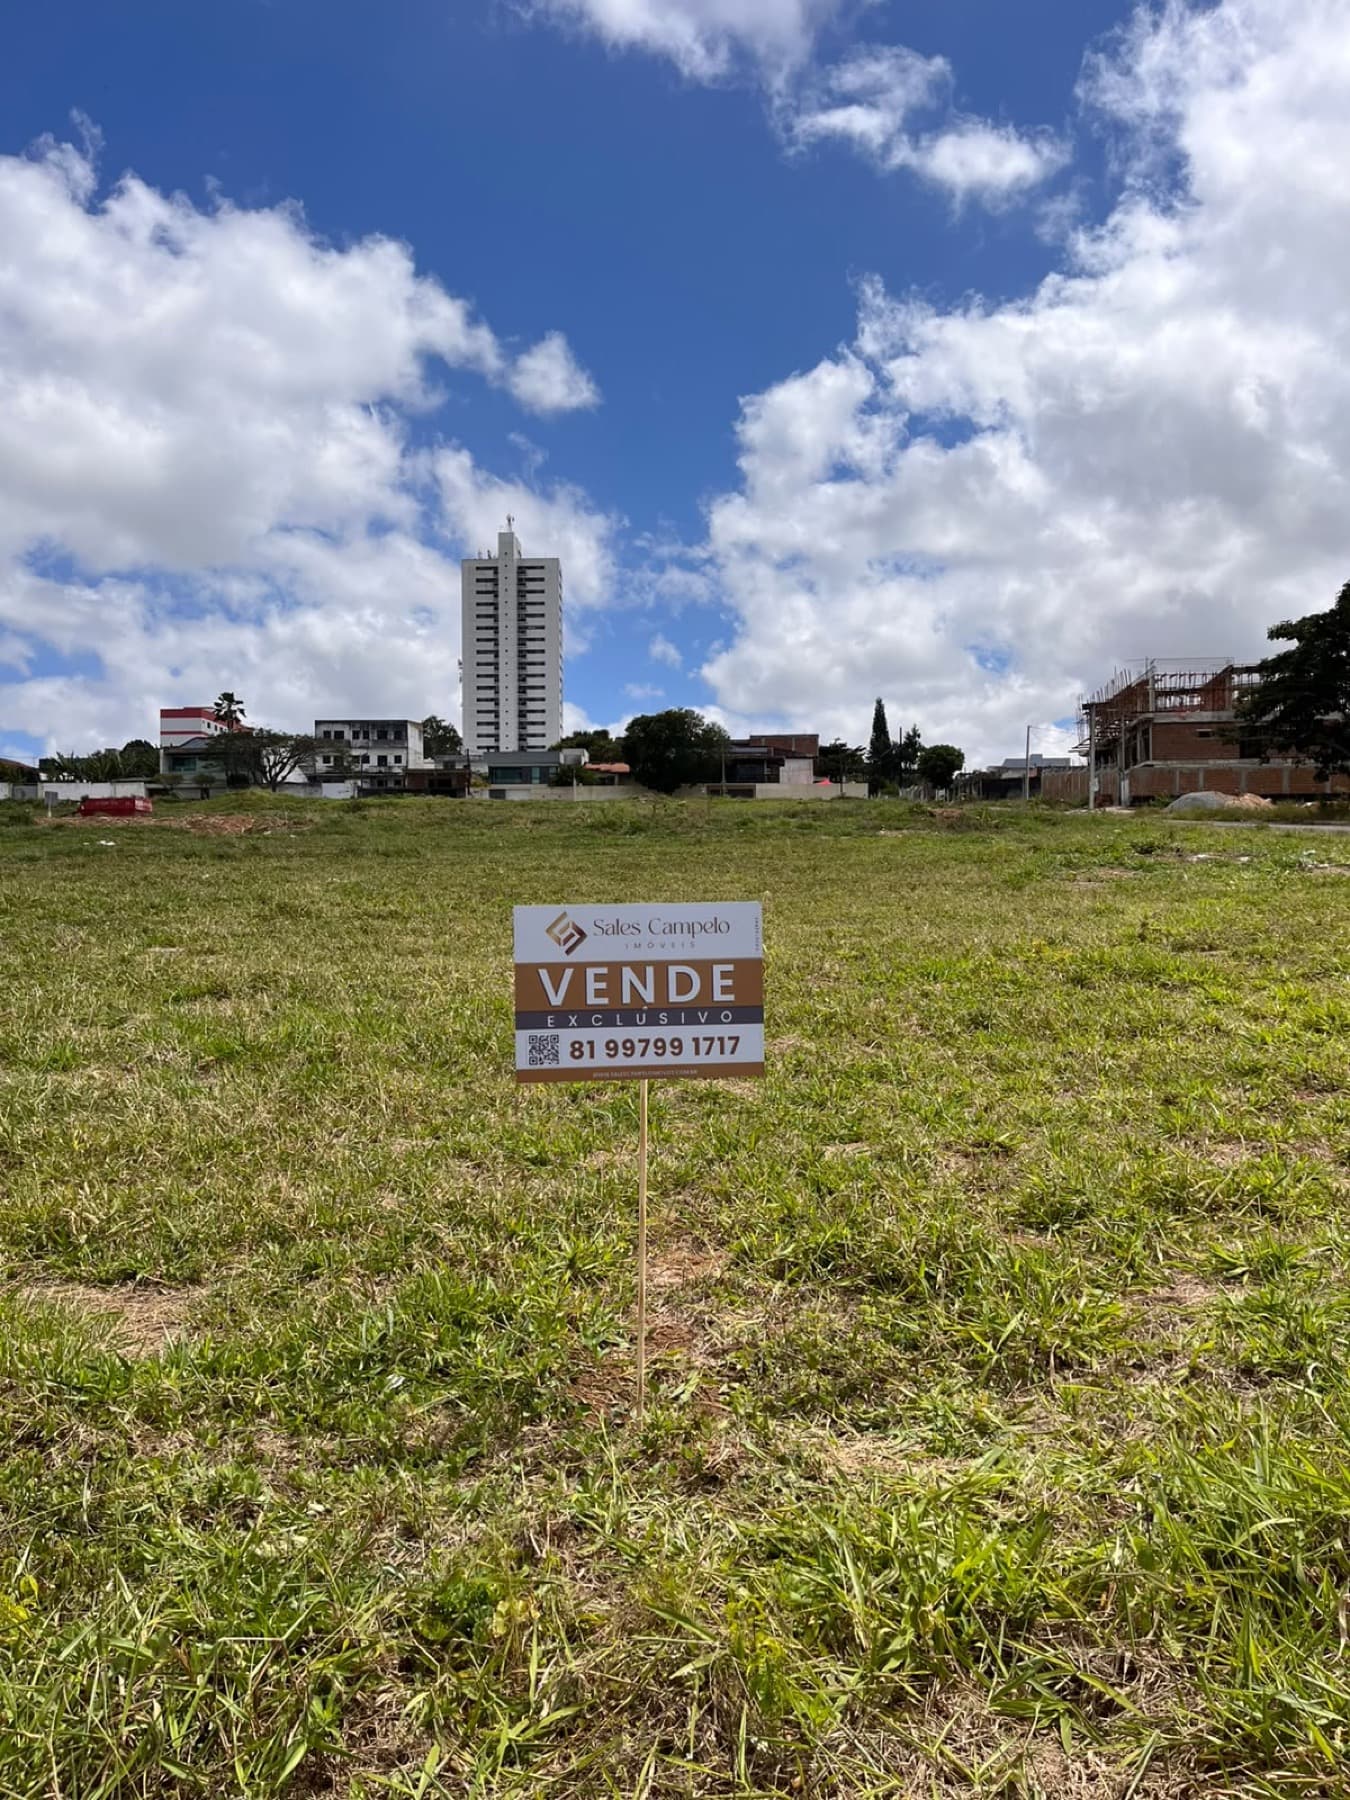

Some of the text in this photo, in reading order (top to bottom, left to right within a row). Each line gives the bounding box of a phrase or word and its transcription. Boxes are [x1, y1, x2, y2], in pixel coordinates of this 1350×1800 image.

[593, 918, 641, 937] Sales
[648, 916, 731, 938] Campelo
[537, 964, 736, 1007] VENDE
[547, 1010, 733, 1028] EXCLUSIVO
[569, 1036, 741, 1060] 81 99799 1717
